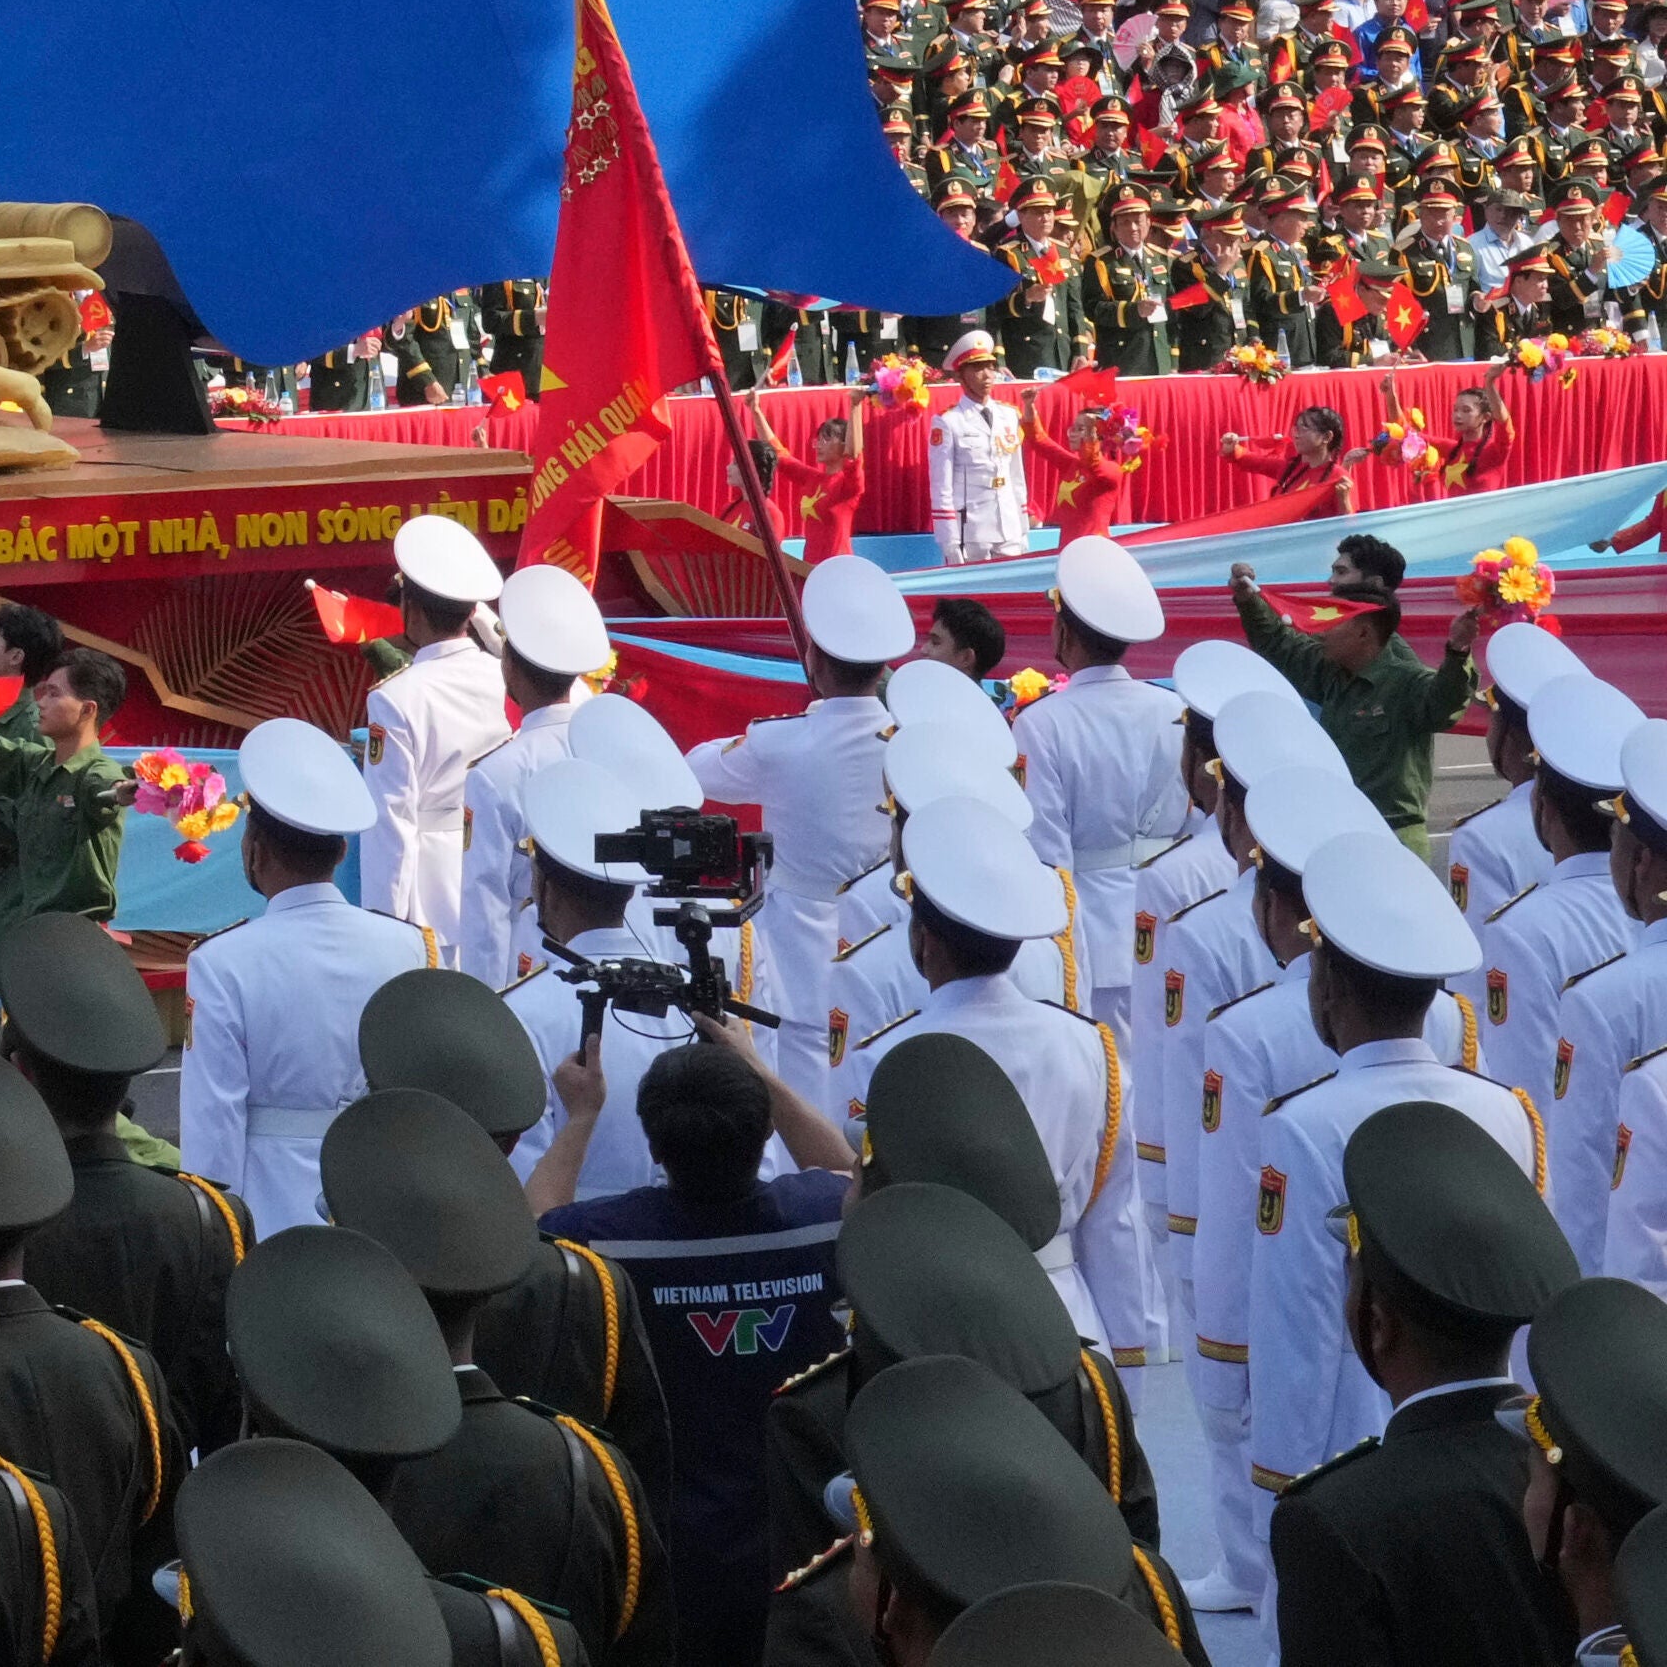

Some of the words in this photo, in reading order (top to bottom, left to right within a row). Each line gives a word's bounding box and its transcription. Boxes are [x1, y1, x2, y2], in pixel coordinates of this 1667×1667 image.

[559, 420, 608, 470] HẢI
[66, 515, 141, 564] MỘT
[148, 510, 231, 561] NHÀ,
[235, 510, 309, 549] NON
[317, 501, 403, 544] SÔNG
[652, 1284, 729, 1305] VIETNAM
[733, 1273, 824, 1303] TELEVISION
[686, 1303, 797, 1356] VTV
